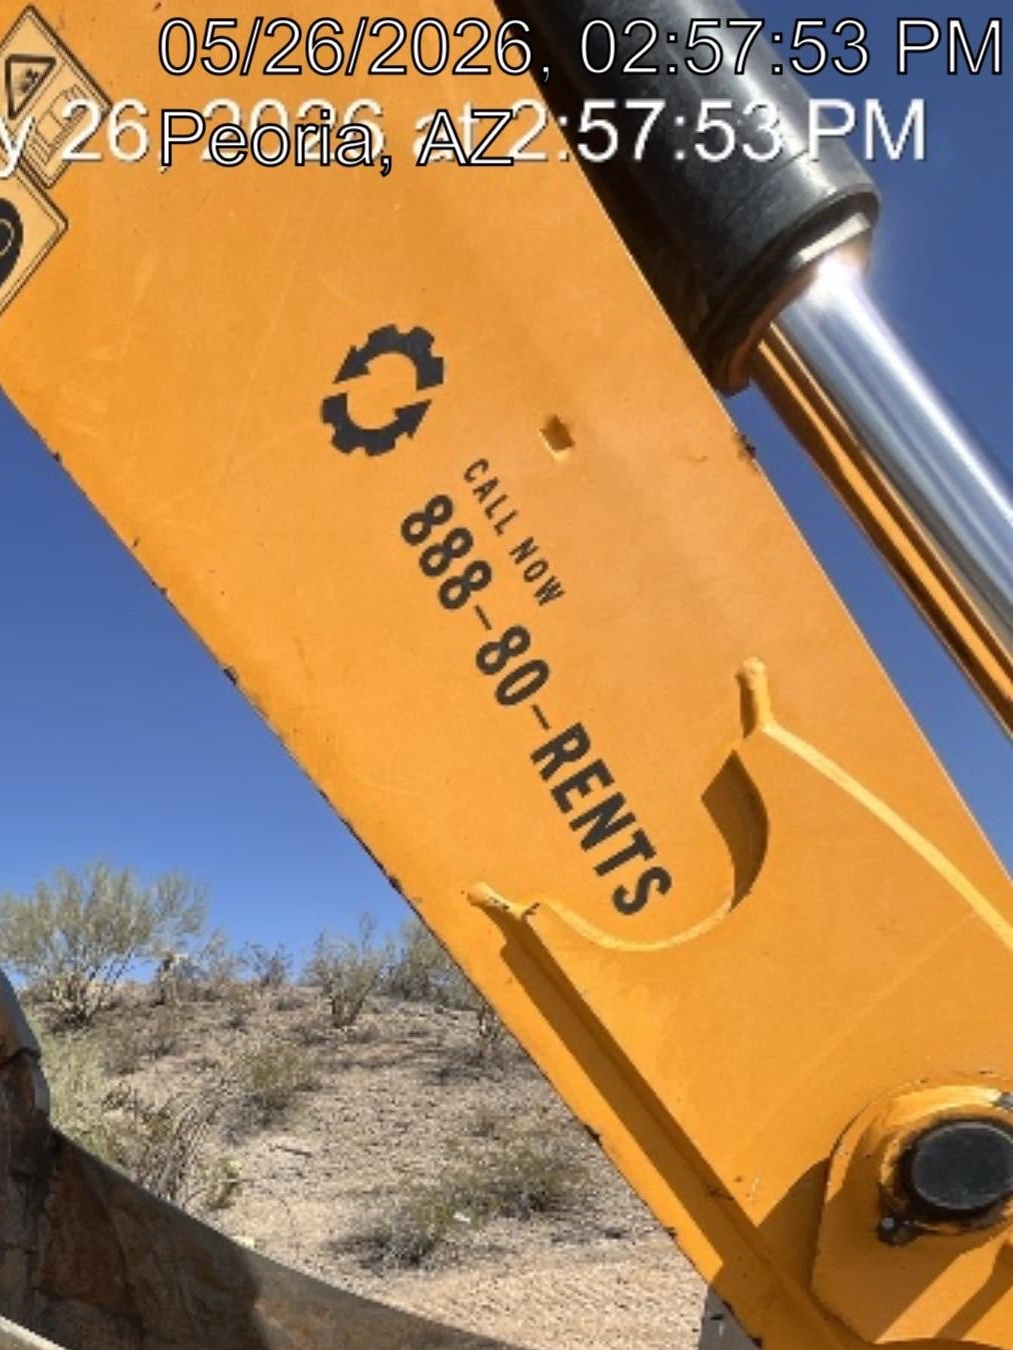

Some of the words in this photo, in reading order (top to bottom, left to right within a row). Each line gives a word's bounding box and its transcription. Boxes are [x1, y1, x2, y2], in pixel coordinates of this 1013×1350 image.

[463, 458, 520, 538] CALL
[508, 534, 565, 607] NOW
[400, 493, 673, 917] 888-80-RENTS
